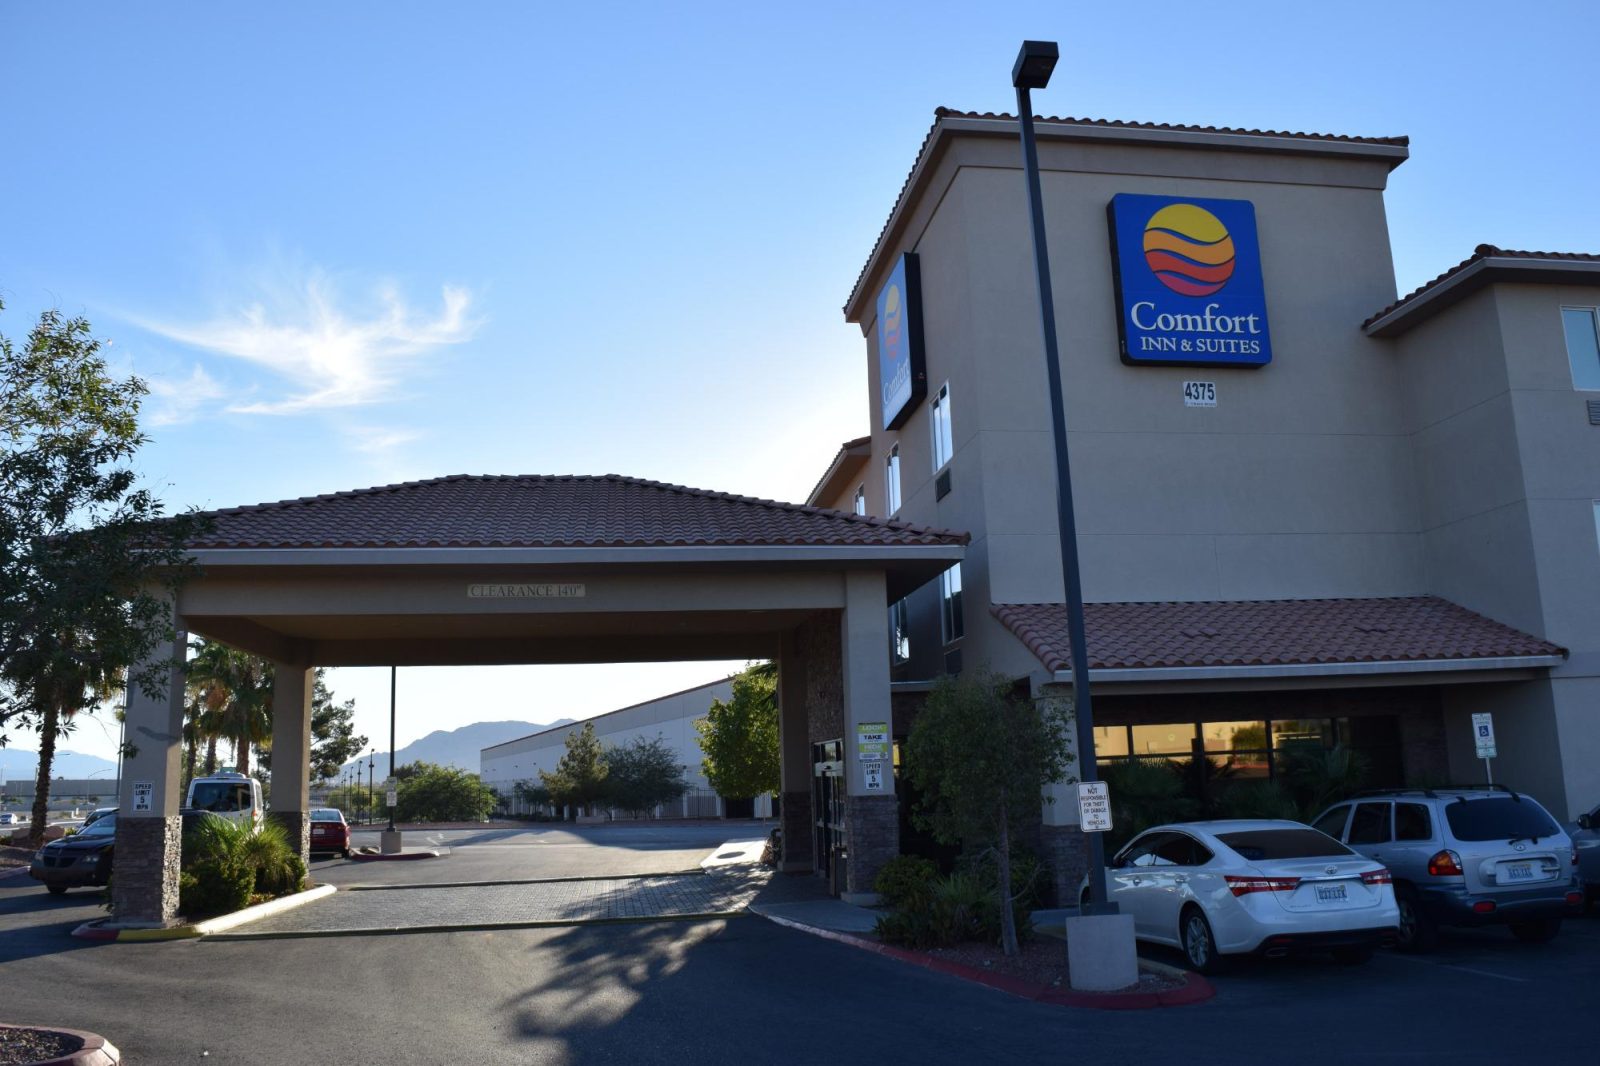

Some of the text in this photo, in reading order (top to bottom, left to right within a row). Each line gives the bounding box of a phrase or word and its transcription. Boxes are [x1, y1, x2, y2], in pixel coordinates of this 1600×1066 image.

[1131, 302, 1261, 334] Comfort
[1141, 336, 1260, 354] INN & SUITES
[883, 357, 909, 404] Comfort
[1184, 382, 1215, 400] 4375
[471, 584, 553, 597] CLEARANCE
[1087, 787, 1098, 795] NOT
